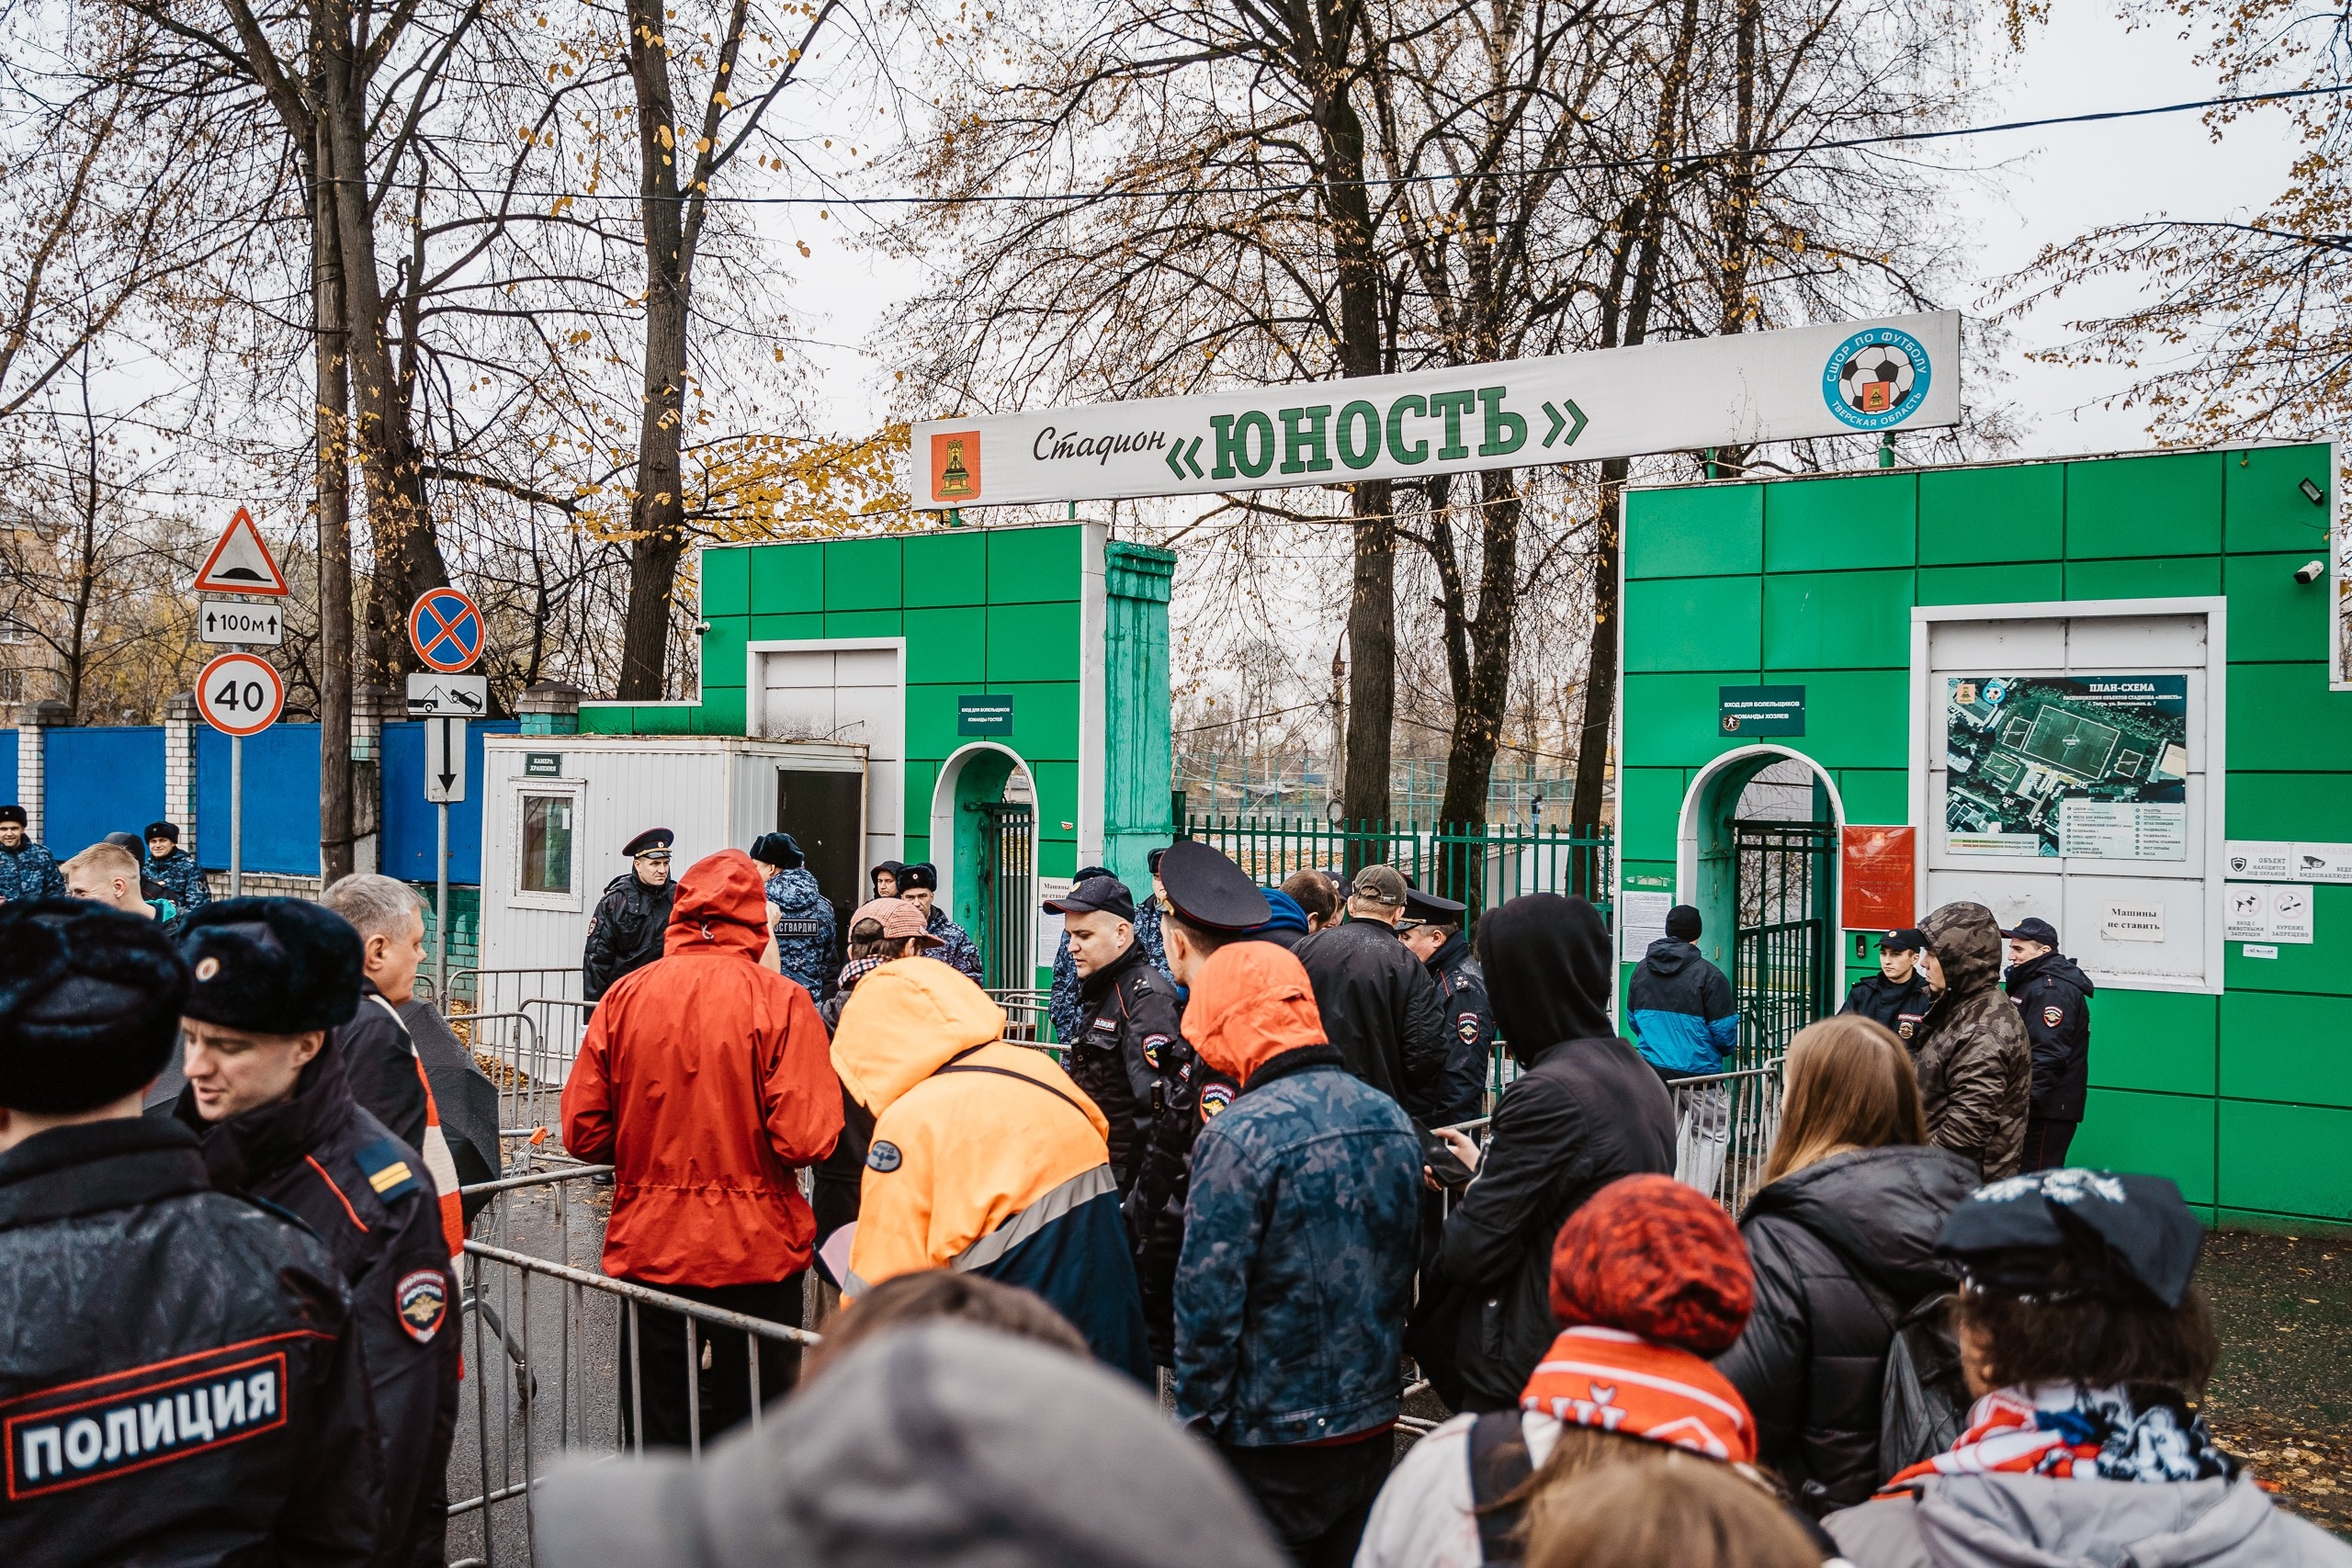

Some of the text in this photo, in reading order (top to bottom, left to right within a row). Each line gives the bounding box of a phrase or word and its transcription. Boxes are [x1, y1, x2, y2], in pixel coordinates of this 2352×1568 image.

[1826, 331, 1928, 382] СШОР ПО ФУТБОЛУ
[1831, 392, 1922, 426] ТВЕРСКАЯ ОБЛАСТЬ
[1033, 426, 1166, 466] Стадион
[214, 680, 264, 712] 40
[2089, 683, 2155, 693] ПЛАН-СХЕМА
[2111, 908, 2157, 917] Машины
[774, 922, 817, 932] ОСГВАРДИЯ
[398, 1272, 445, 1293] ПОЛИЦИЯ
[402, 1283, 443, 1305] РОССИЯ
[22, 1370, 277, 1482] ПОЛИЦИЯ
